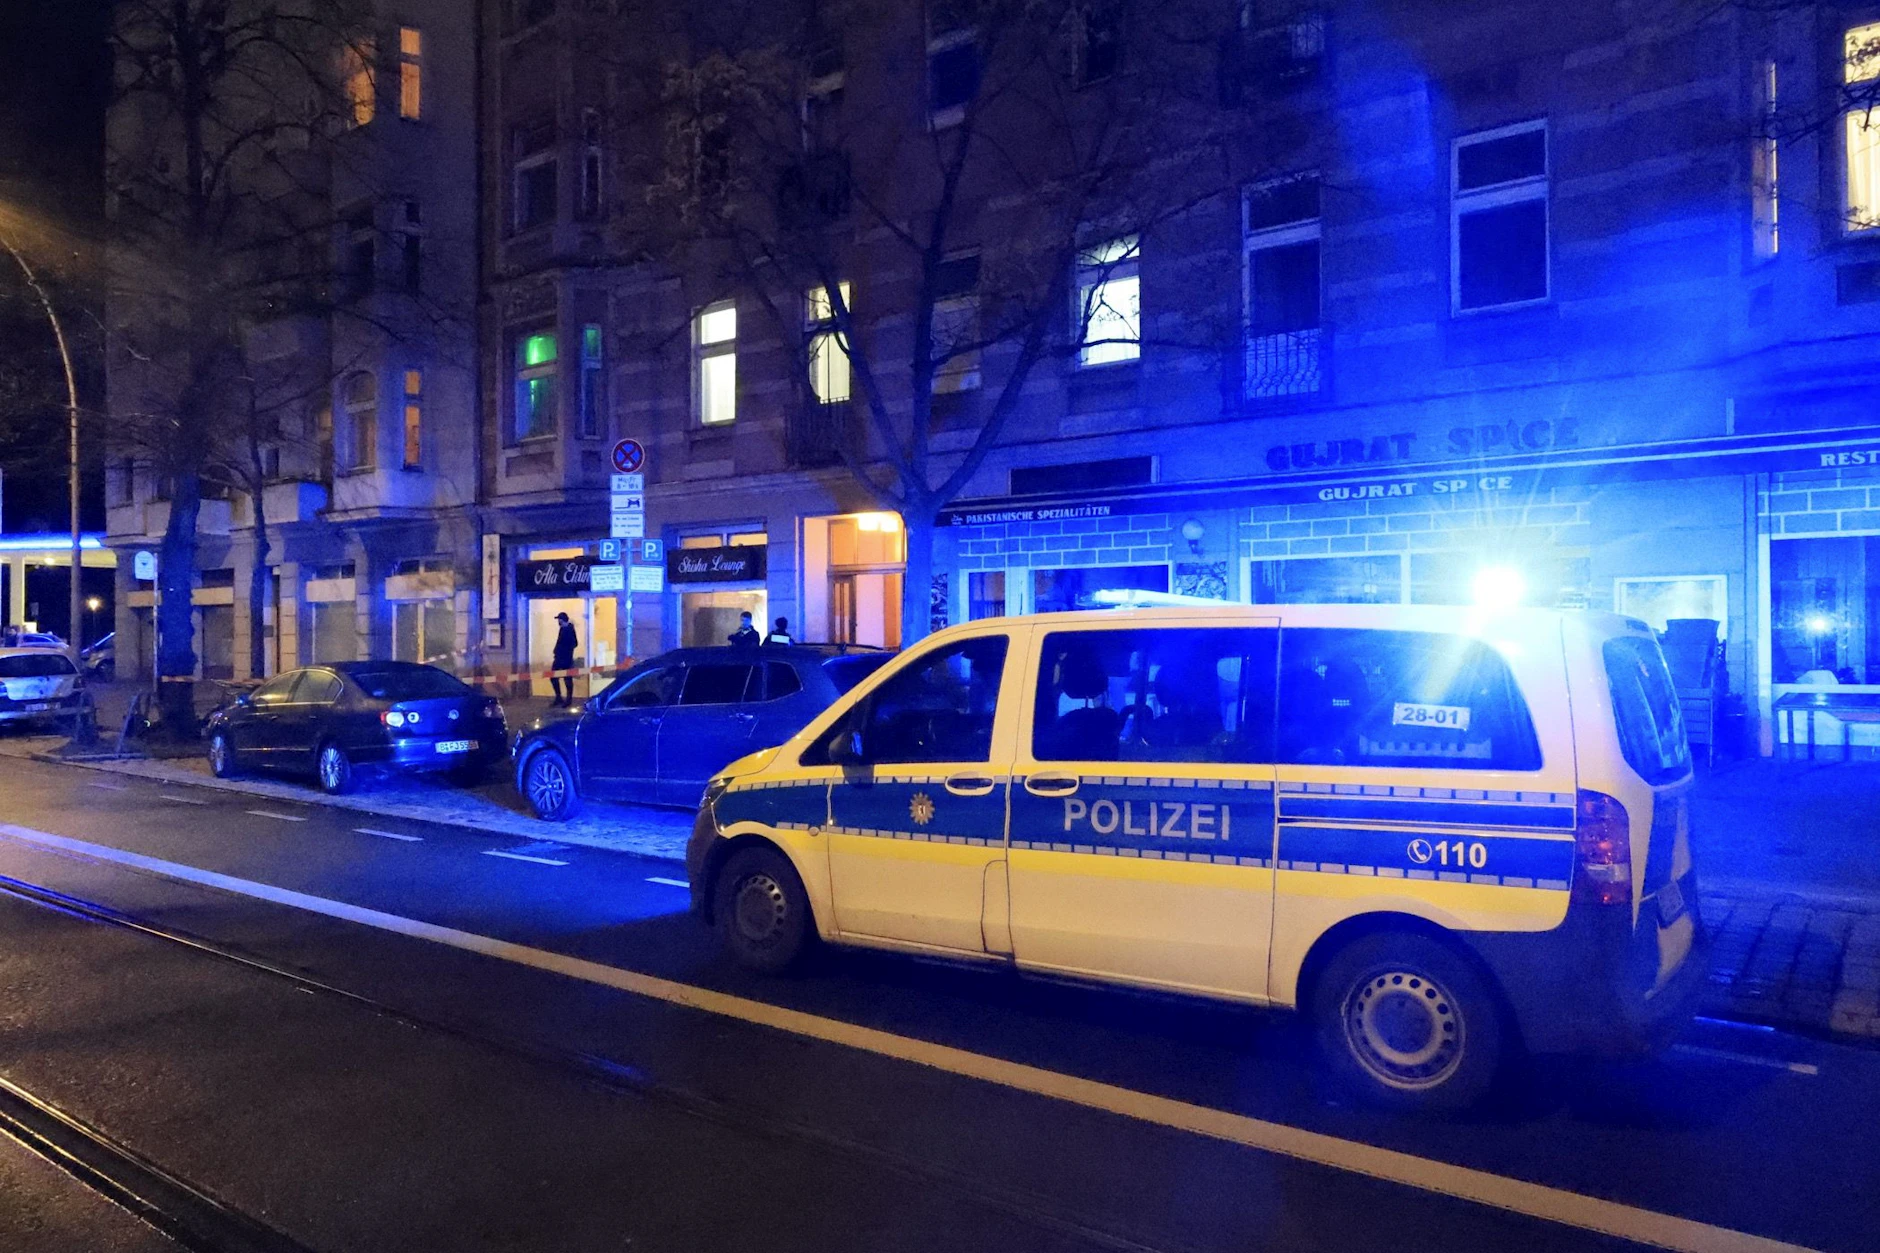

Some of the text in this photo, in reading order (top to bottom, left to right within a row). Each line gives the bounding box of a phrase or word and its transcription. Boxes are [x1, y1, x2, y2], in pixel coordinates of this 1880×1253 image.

[1266, 432, 1417, 471] GUJRAT
[1318, 482, 1418, 501] GUJRAT
[966, 511, 1034, 524] PAKISTANISCHE
[603, 542, 615, 558] P
[645, 542, 657, 558] P
[678, 556, 708, 573] Shisha
[711, 554, 746, 576] Lounge
[1402, 707, 1458, 725] 28-01
[1064, 798, 1230, 841] POLIZEI
[1435, 840, 1487, 868] 110
